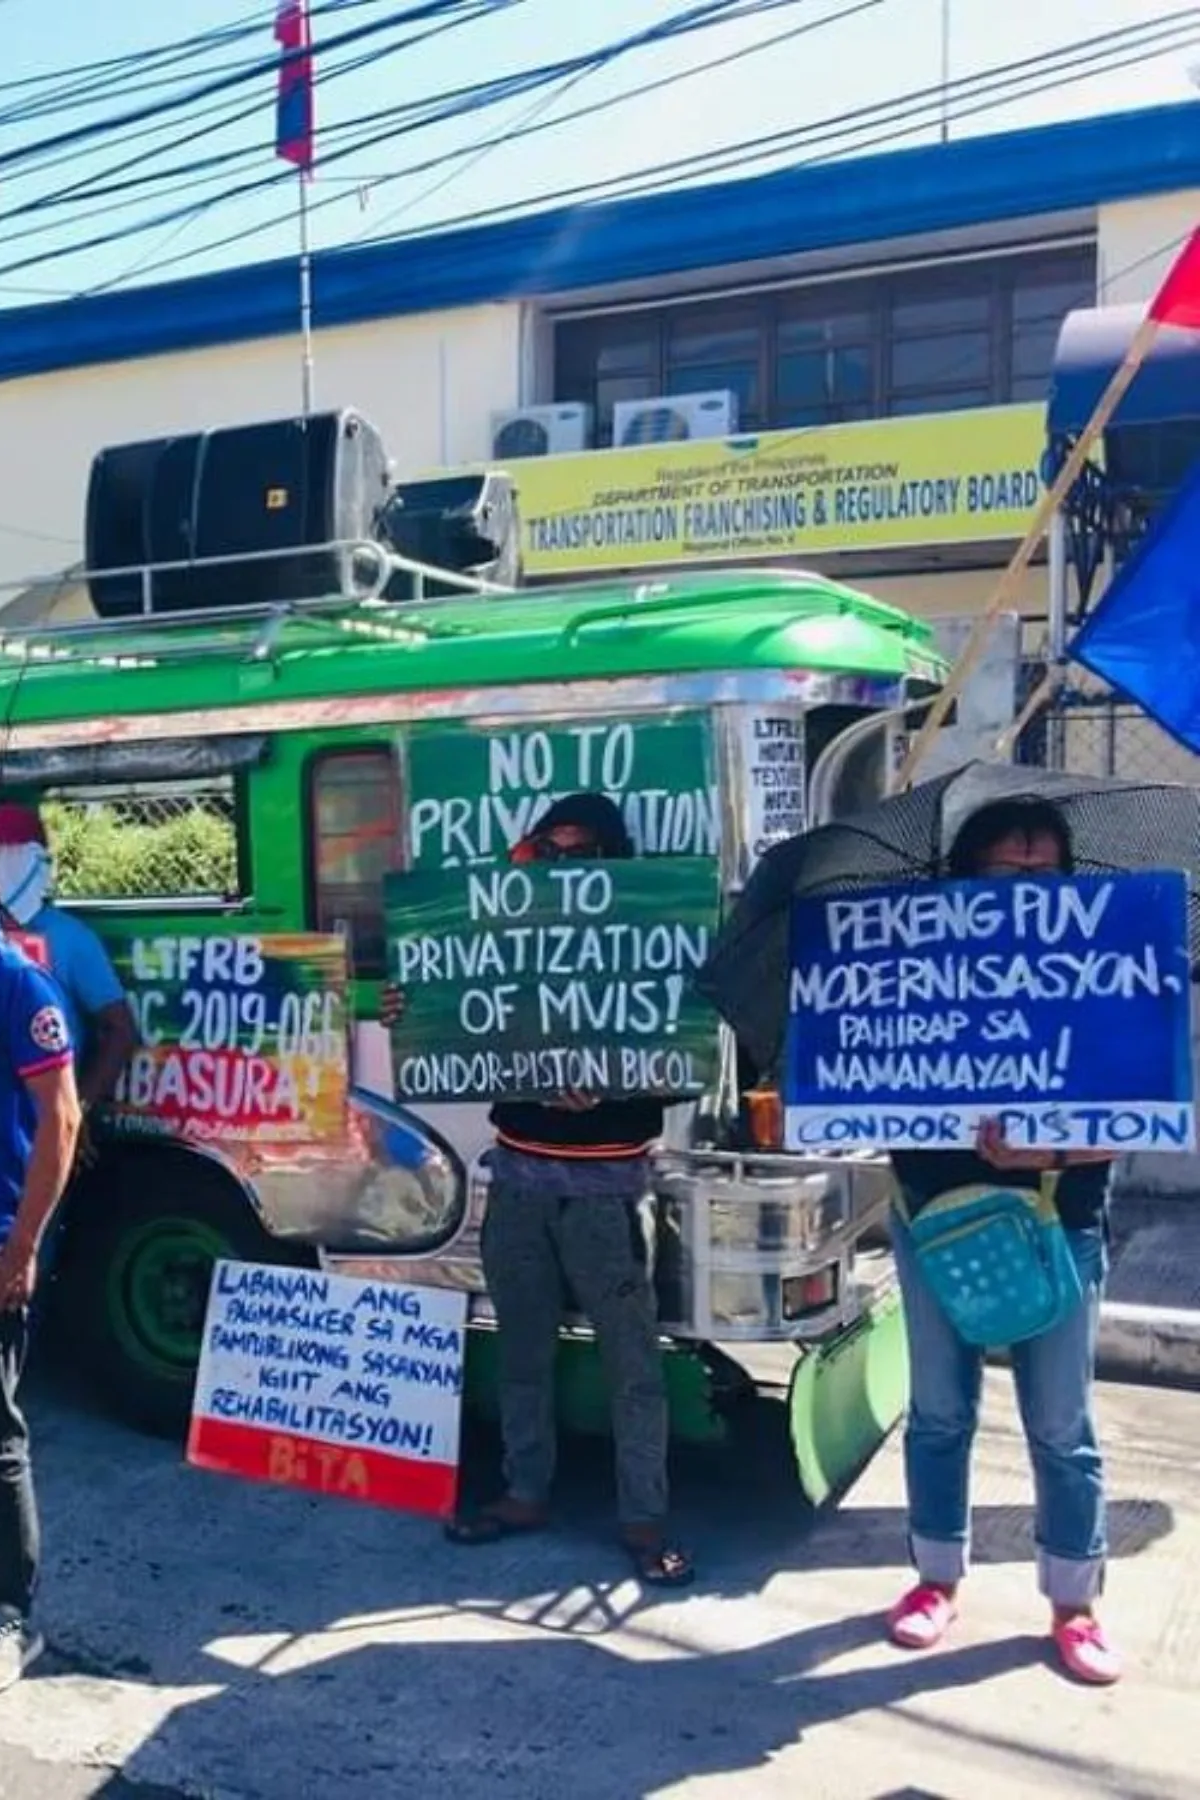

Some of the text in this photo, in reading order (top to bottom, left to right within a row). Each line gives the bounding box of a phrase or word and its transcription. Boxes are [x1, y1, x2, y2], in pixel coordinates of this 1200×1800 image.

[528, 470, 1038, 551] TRANSPORTATION FRANCHISING & REGULATORY BOARD
[593, 463, 899, 507] DEPARTMENT OF TRANSPORTATION
[488, 723, 634, 793] NO TO
[469, 868, 612, 920] NO TO
[826, 883, 1114, 953] PEKENG PUV
[133, 935, 265, 987] LTFRB
[401, 925, 708, 983] PRIVATIZATION
[460, 975, 685, 1035] OF MVIS!
[839, 1008, 1032, 1049] PAHIRAP SA
[400, 1047, 705, 1096] CONDOR-PISTON BICOL
[217, 1264, 421, 1318] LABANAN ANG
[365, 1318, 394, 1342] SA
[403, 1323, 460, 1354] MGA
[258, 1366, 391, 1408] IGIIT ANG
[209, 1388, 434, 1456] REHABILITASYON!
